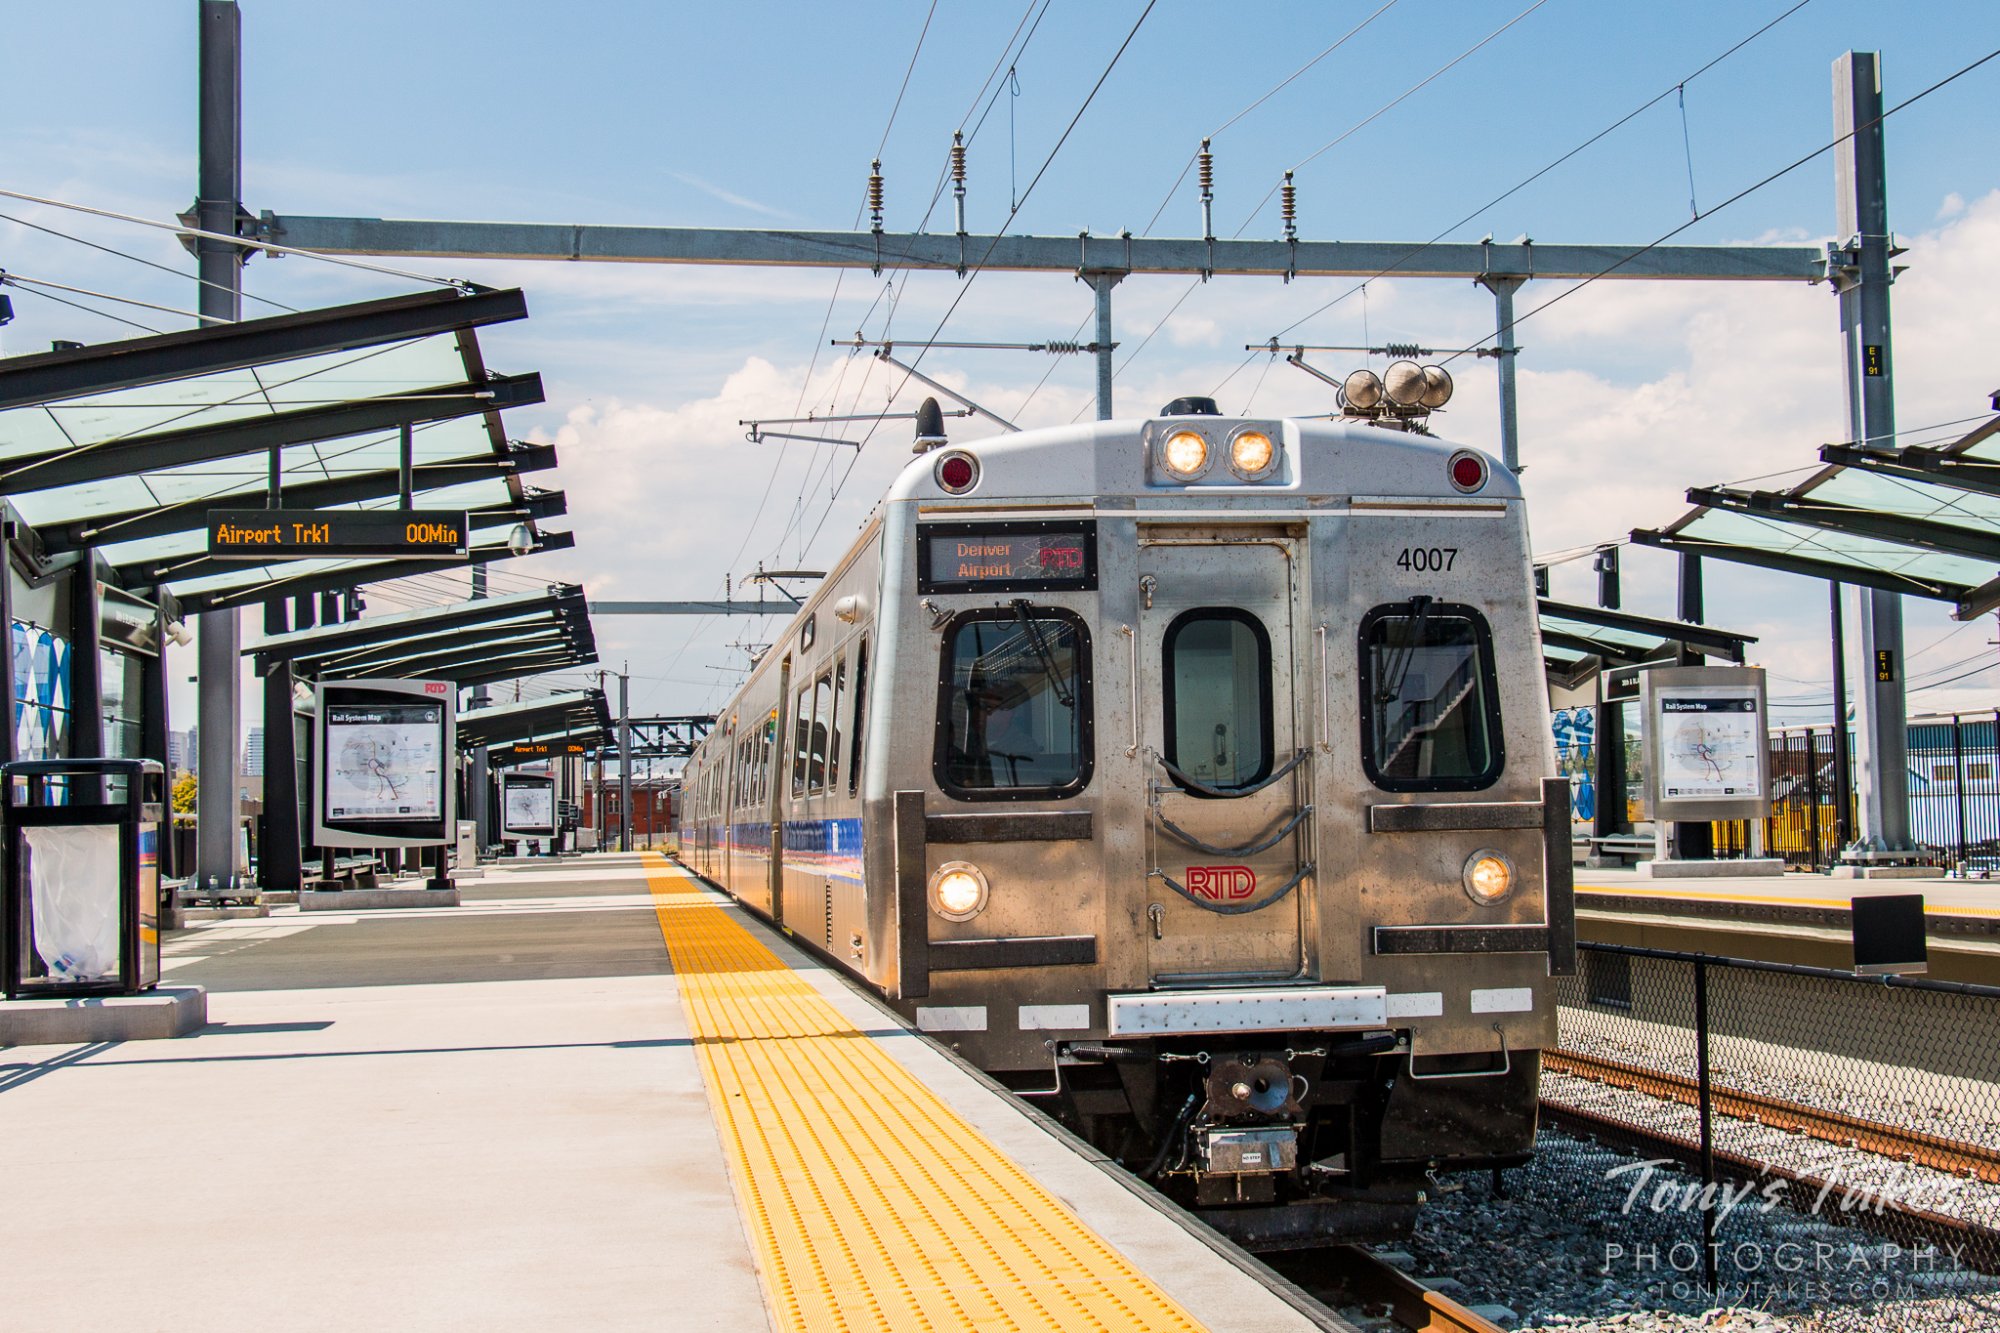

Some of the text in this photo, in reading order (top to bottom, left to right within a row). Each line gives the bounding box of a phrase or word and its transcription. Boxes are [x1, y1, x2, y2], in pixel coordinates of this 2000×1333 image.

[1869, 347, 1876, 355] E
[1868, 366, 1878, 375] 91
[217, 524, 281, 544] Airport
[292, 523, 329, 543] Trk1
[957, 544, 1011, 557] Denver
[1039, 547, 1083, 569] RTD
[1397, 548, 1458, 572] 4007
[958, 563, 1012, 580] Airport
[1879, 652, 1886, 660] E
[1879, 672, 1889, 680] 91
[424, 683, 447, 693] RTD
[1677, 703, 1696, 711] System
[1696, 703, 1708, 711] Map
[332, 714, 382, 723] Rail System Map
[1186, 866, 1256, 899] RTD
